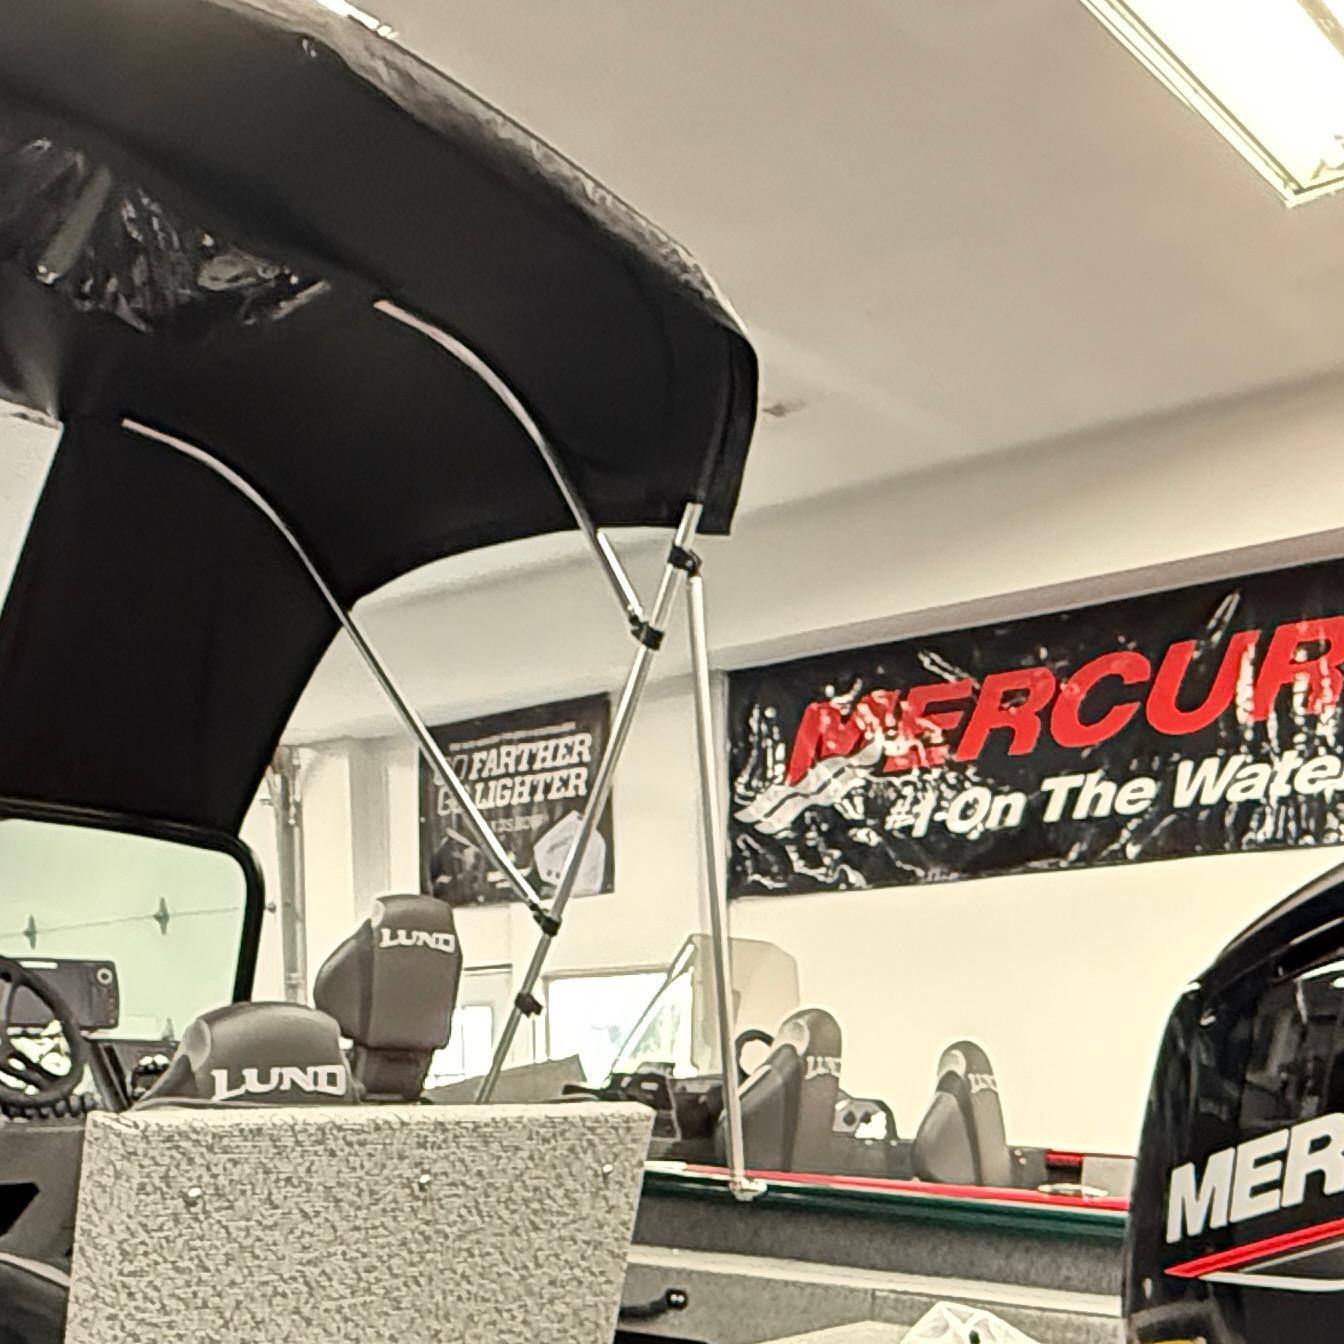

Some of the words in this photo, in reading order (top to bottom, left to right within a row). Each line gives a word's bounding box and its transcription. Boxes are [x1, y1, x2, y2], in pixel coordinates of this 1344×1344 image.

[469, 733, 593, 780] FARTHER
[474, 767, 588, 810] LIGHTER
[1041, 769, 1156, 823] The
[379, 928, 455, 953] LUND
[211, 1065, 345, 1101] LUND
